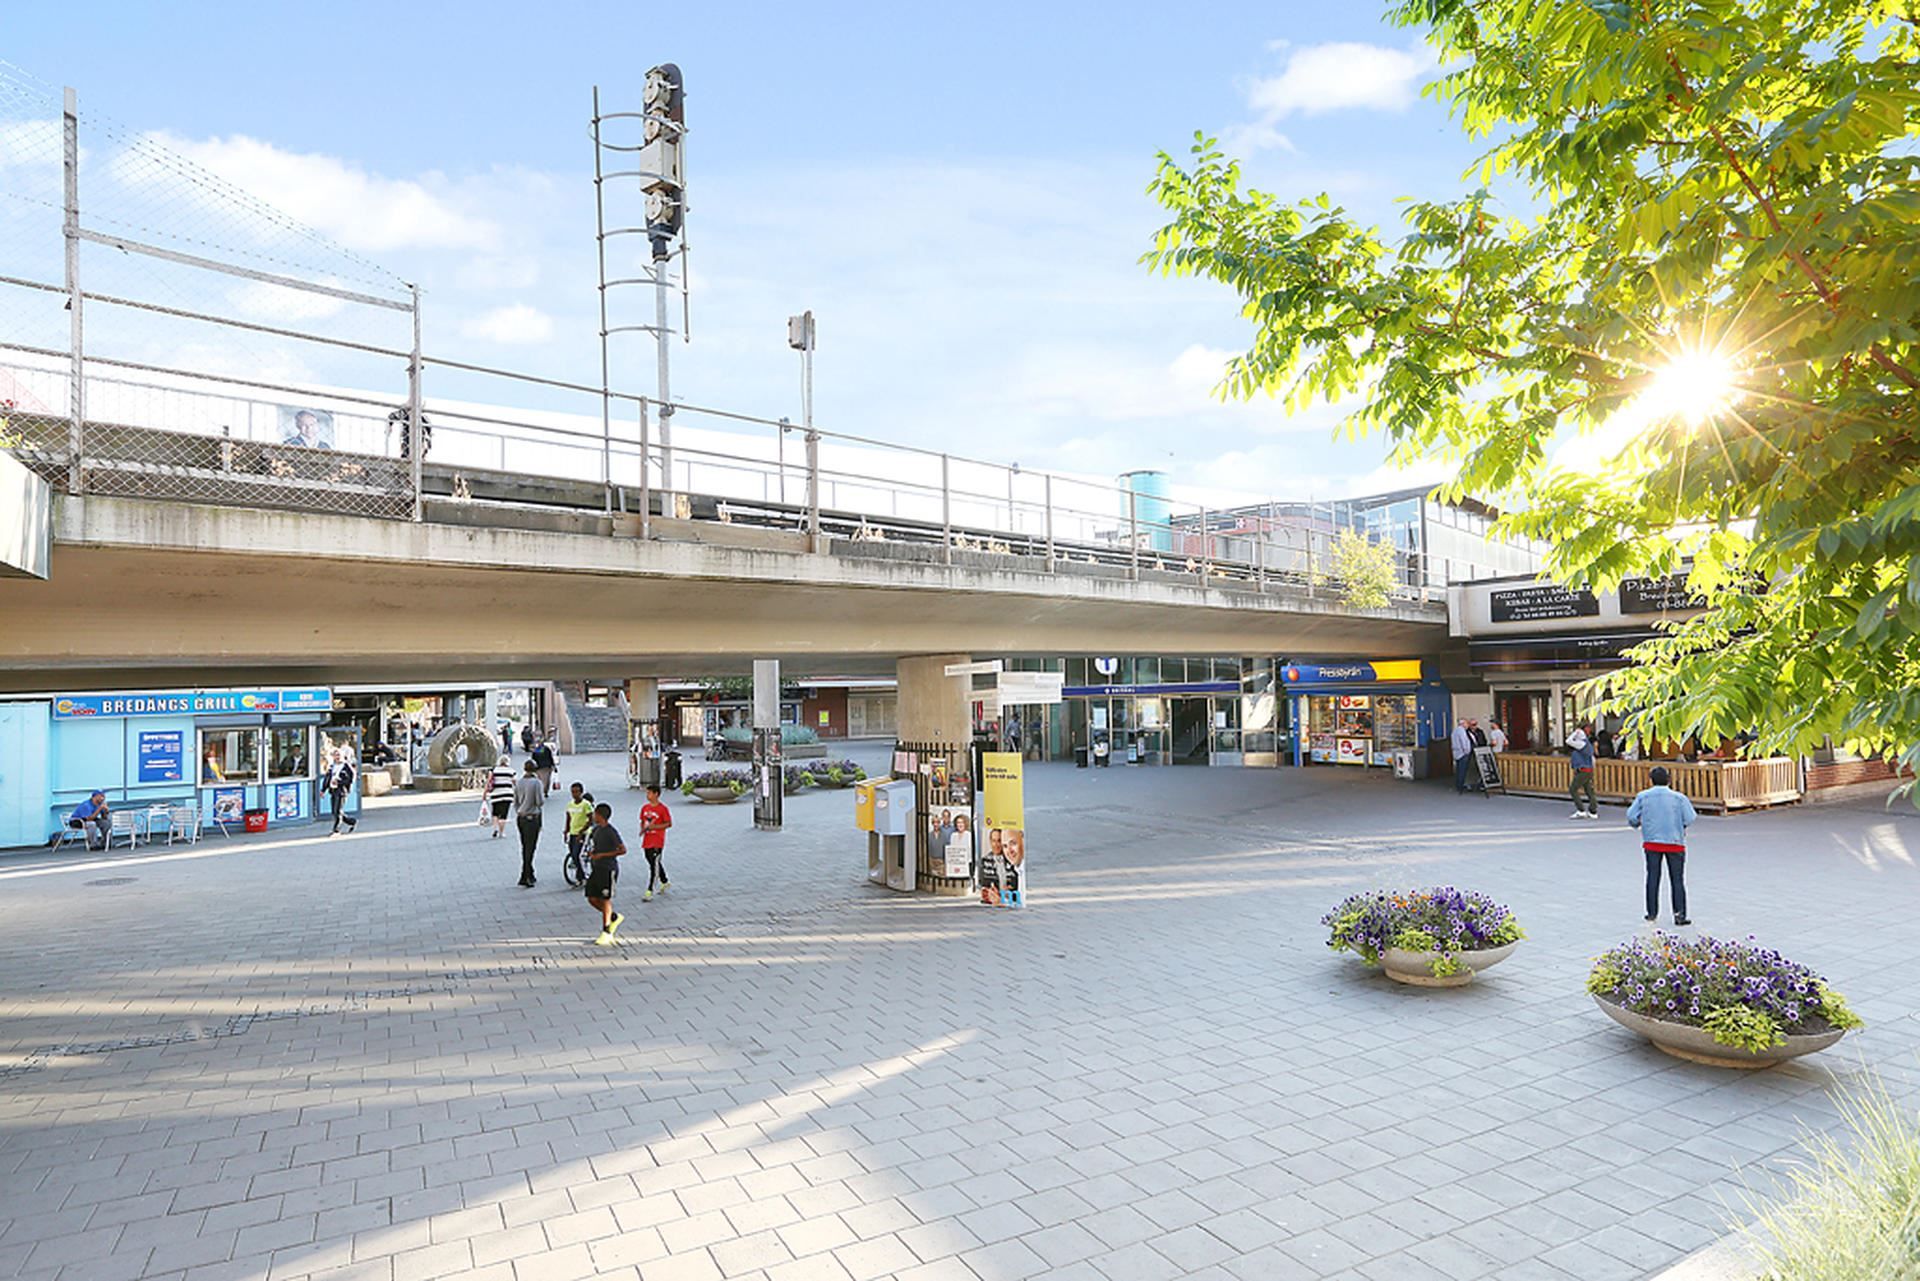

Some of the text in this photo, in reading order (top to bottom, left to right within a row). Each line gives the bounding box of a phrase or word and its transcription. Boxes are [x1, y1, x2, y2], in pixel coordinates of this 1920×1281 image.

[1495, 592, 1517, 600] PIZZA
[102, 697, 188, 713] BREDÄNGS
[194, 697, 236, 711] GRILL
